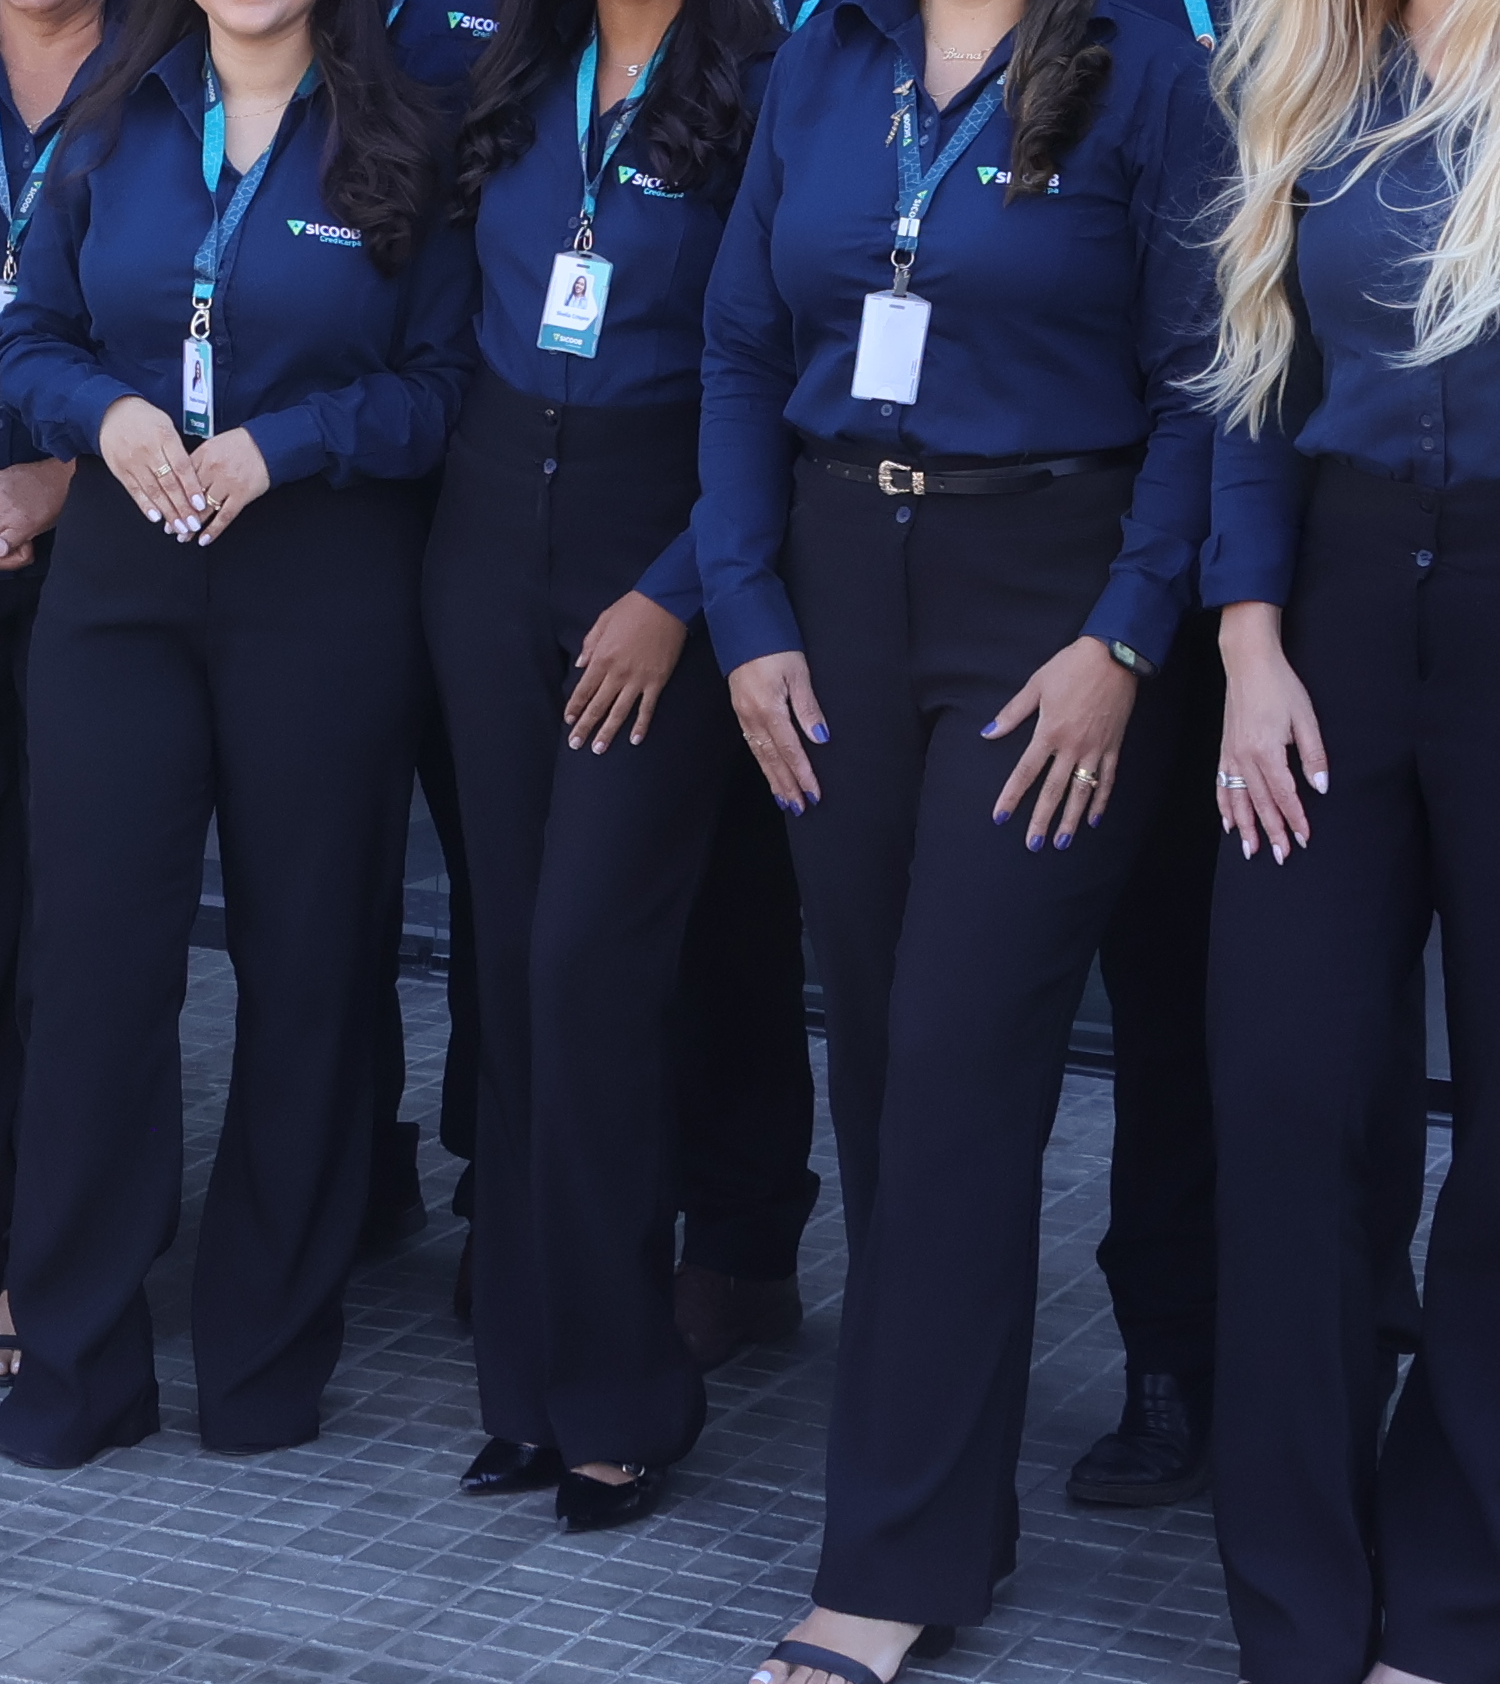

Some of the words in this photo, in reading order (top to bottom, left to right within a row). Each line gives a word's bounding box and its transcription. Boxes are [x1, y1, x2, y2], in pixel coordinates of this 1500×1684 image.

[627, 65, 639, 77] S
[20, 187, 38, 214] SICOOB
[908, 198, 922, 218] SICO
[305, 223, 362, 240] SICOOB
